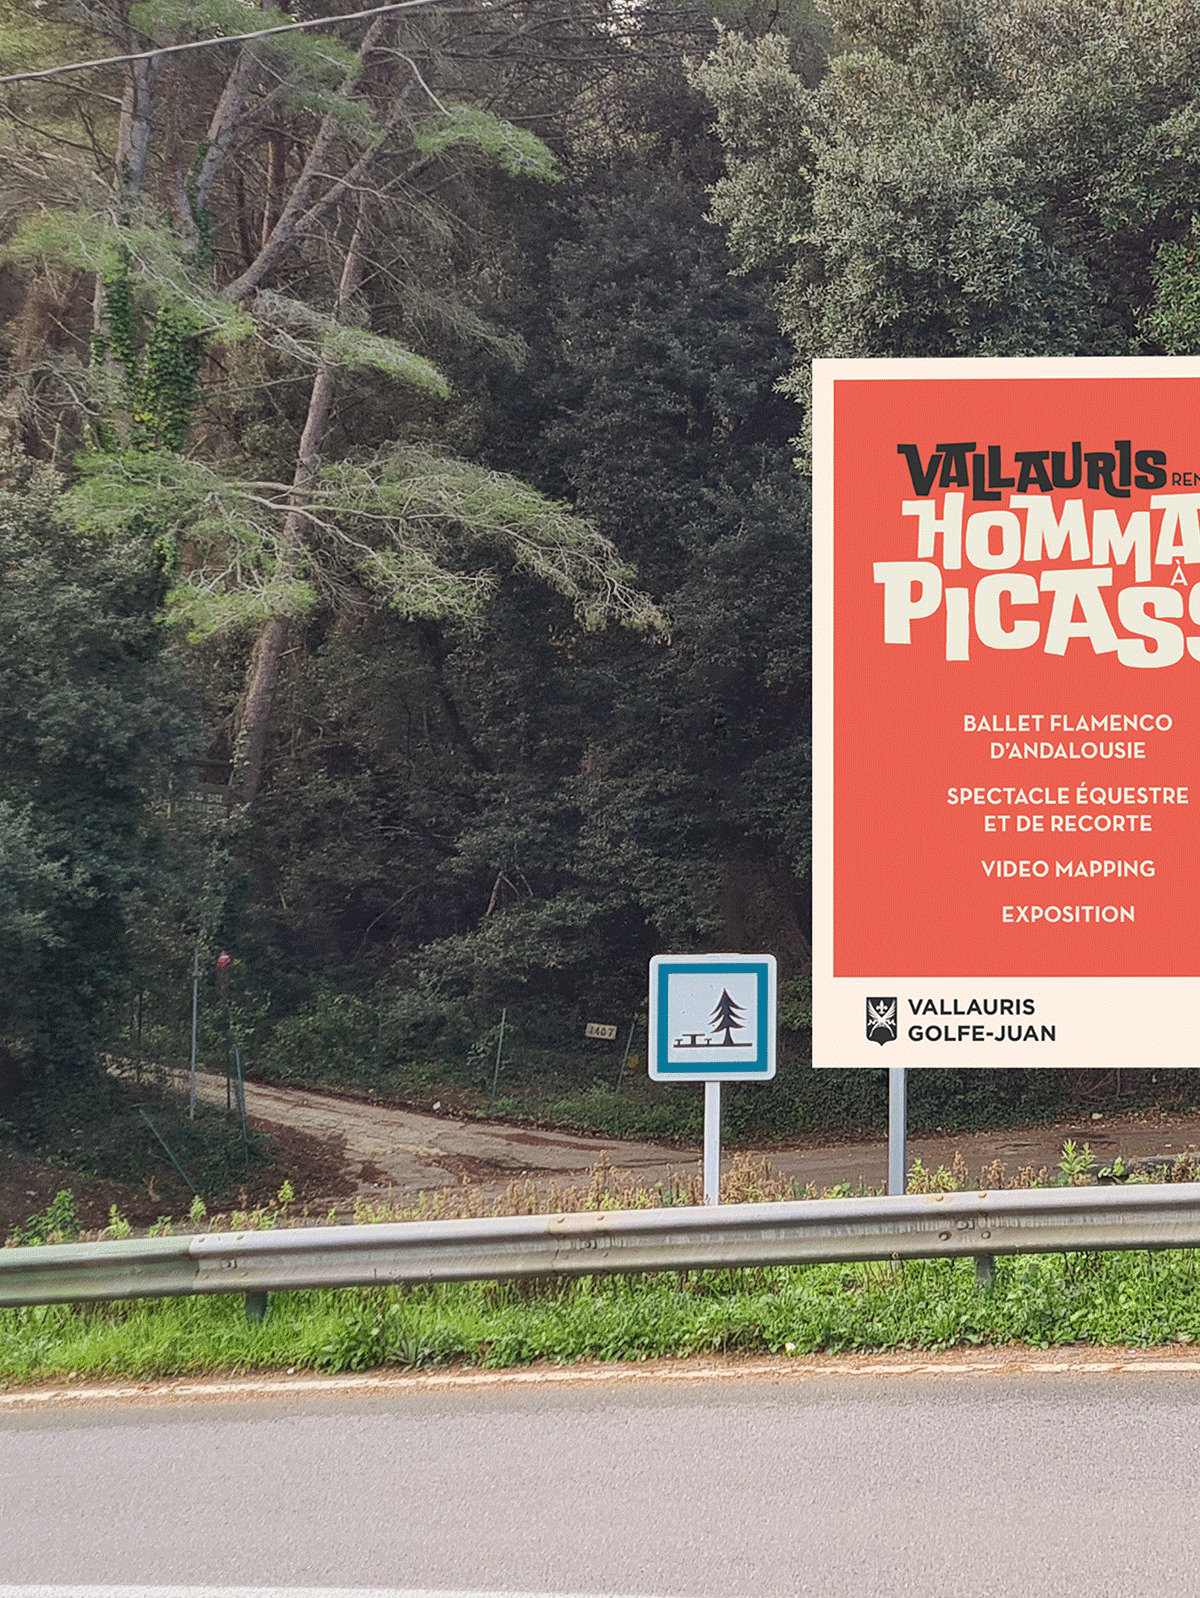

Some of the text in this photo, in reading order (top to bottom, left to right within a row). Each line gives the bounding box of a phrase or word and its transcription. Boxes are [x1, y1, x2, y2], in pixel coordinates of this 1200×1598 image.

[897, 440, 1167, 501] VALLAURIS
[1170, 559, 1188, 586] À
[963, 714, 1173, 732] BALLET FLAMENCO
[947, 781, 1189, 806] SPECTACLE ÉQUESTRE
[984, 814, 1152, 832] ET DE RECORTE
[981, 860, 1156, 878] VIDEO MAPPING
[1002, 905, 1135, 923] EXPOSITION
[908, 998, 1036, 1016] VALLAURIS
[908, 1024, 1056, 1042] GOLFE-JUAN
